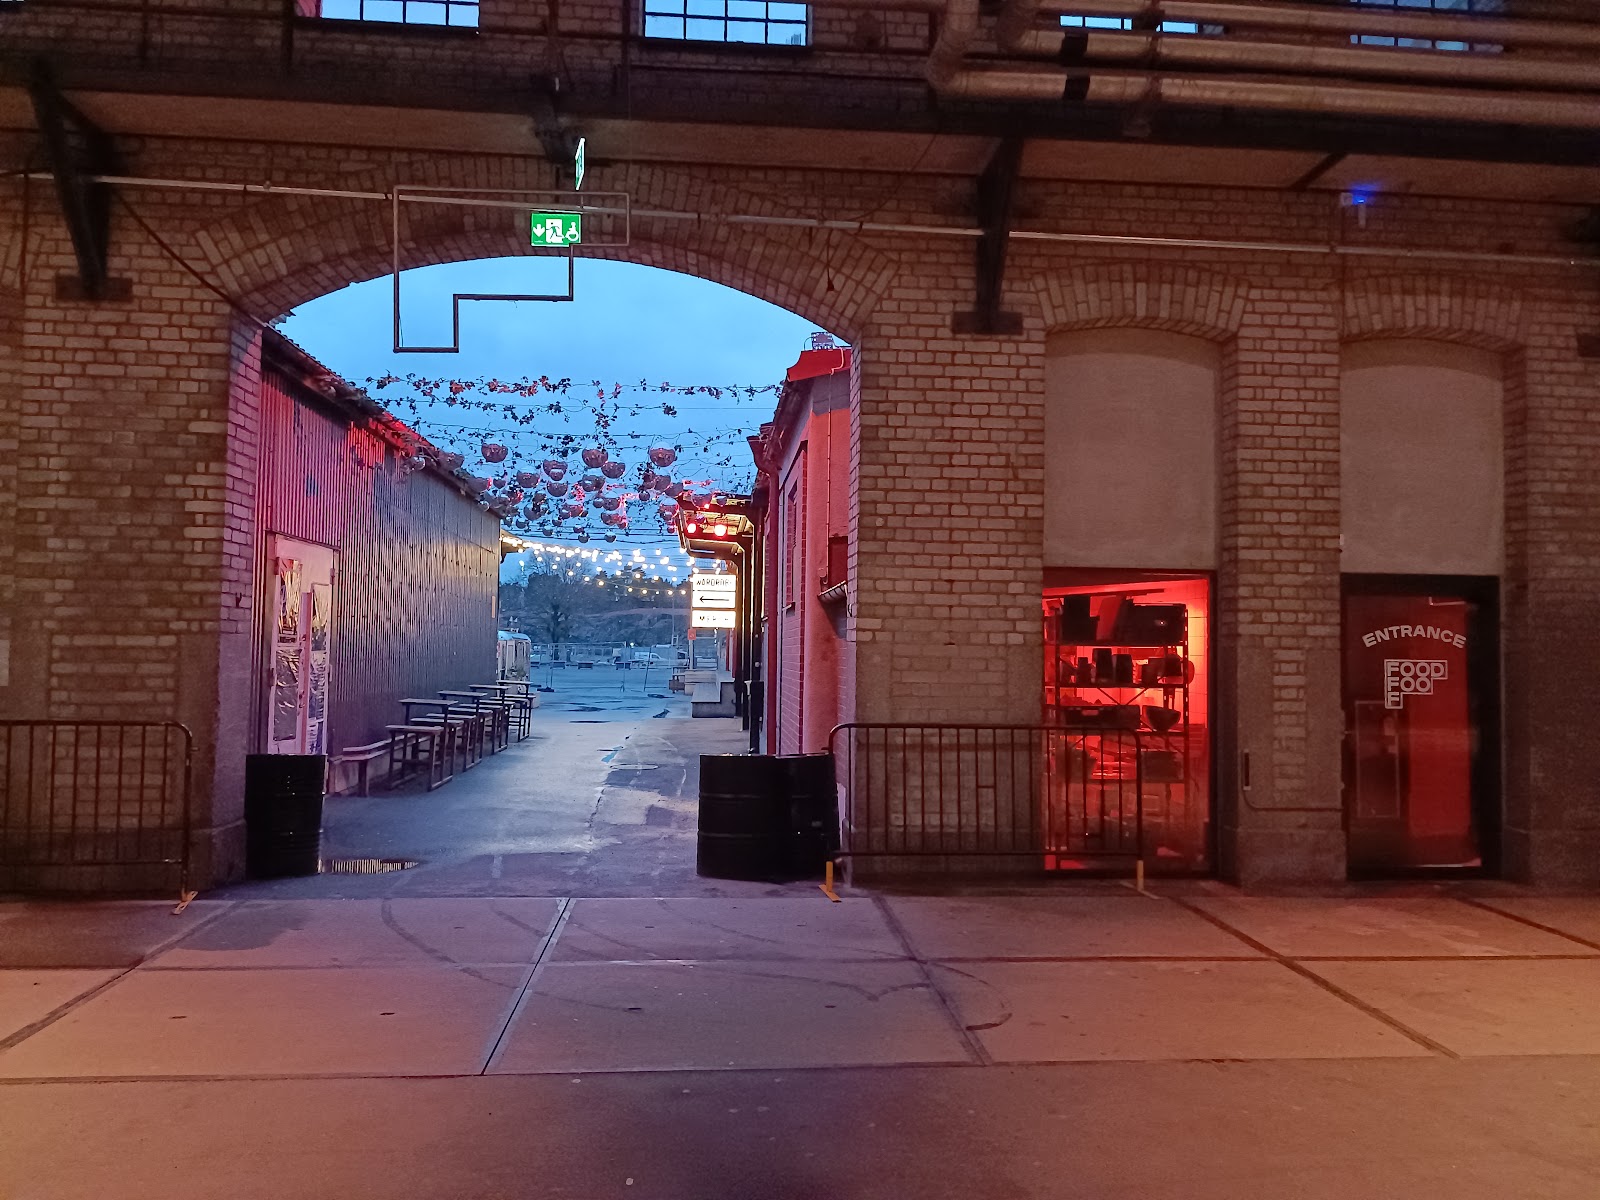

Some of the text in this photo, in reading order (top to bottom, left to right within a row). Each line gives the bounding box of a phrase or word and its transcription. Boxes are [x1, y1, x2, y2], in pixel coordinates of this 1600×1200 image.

[1362, 625, 1467, 648] ENTRANCE
[1387, 662, 1444, 677] FOOD
[1387, 677, 1431, 692] FOO
[1387, 692, 1399, 706] F
